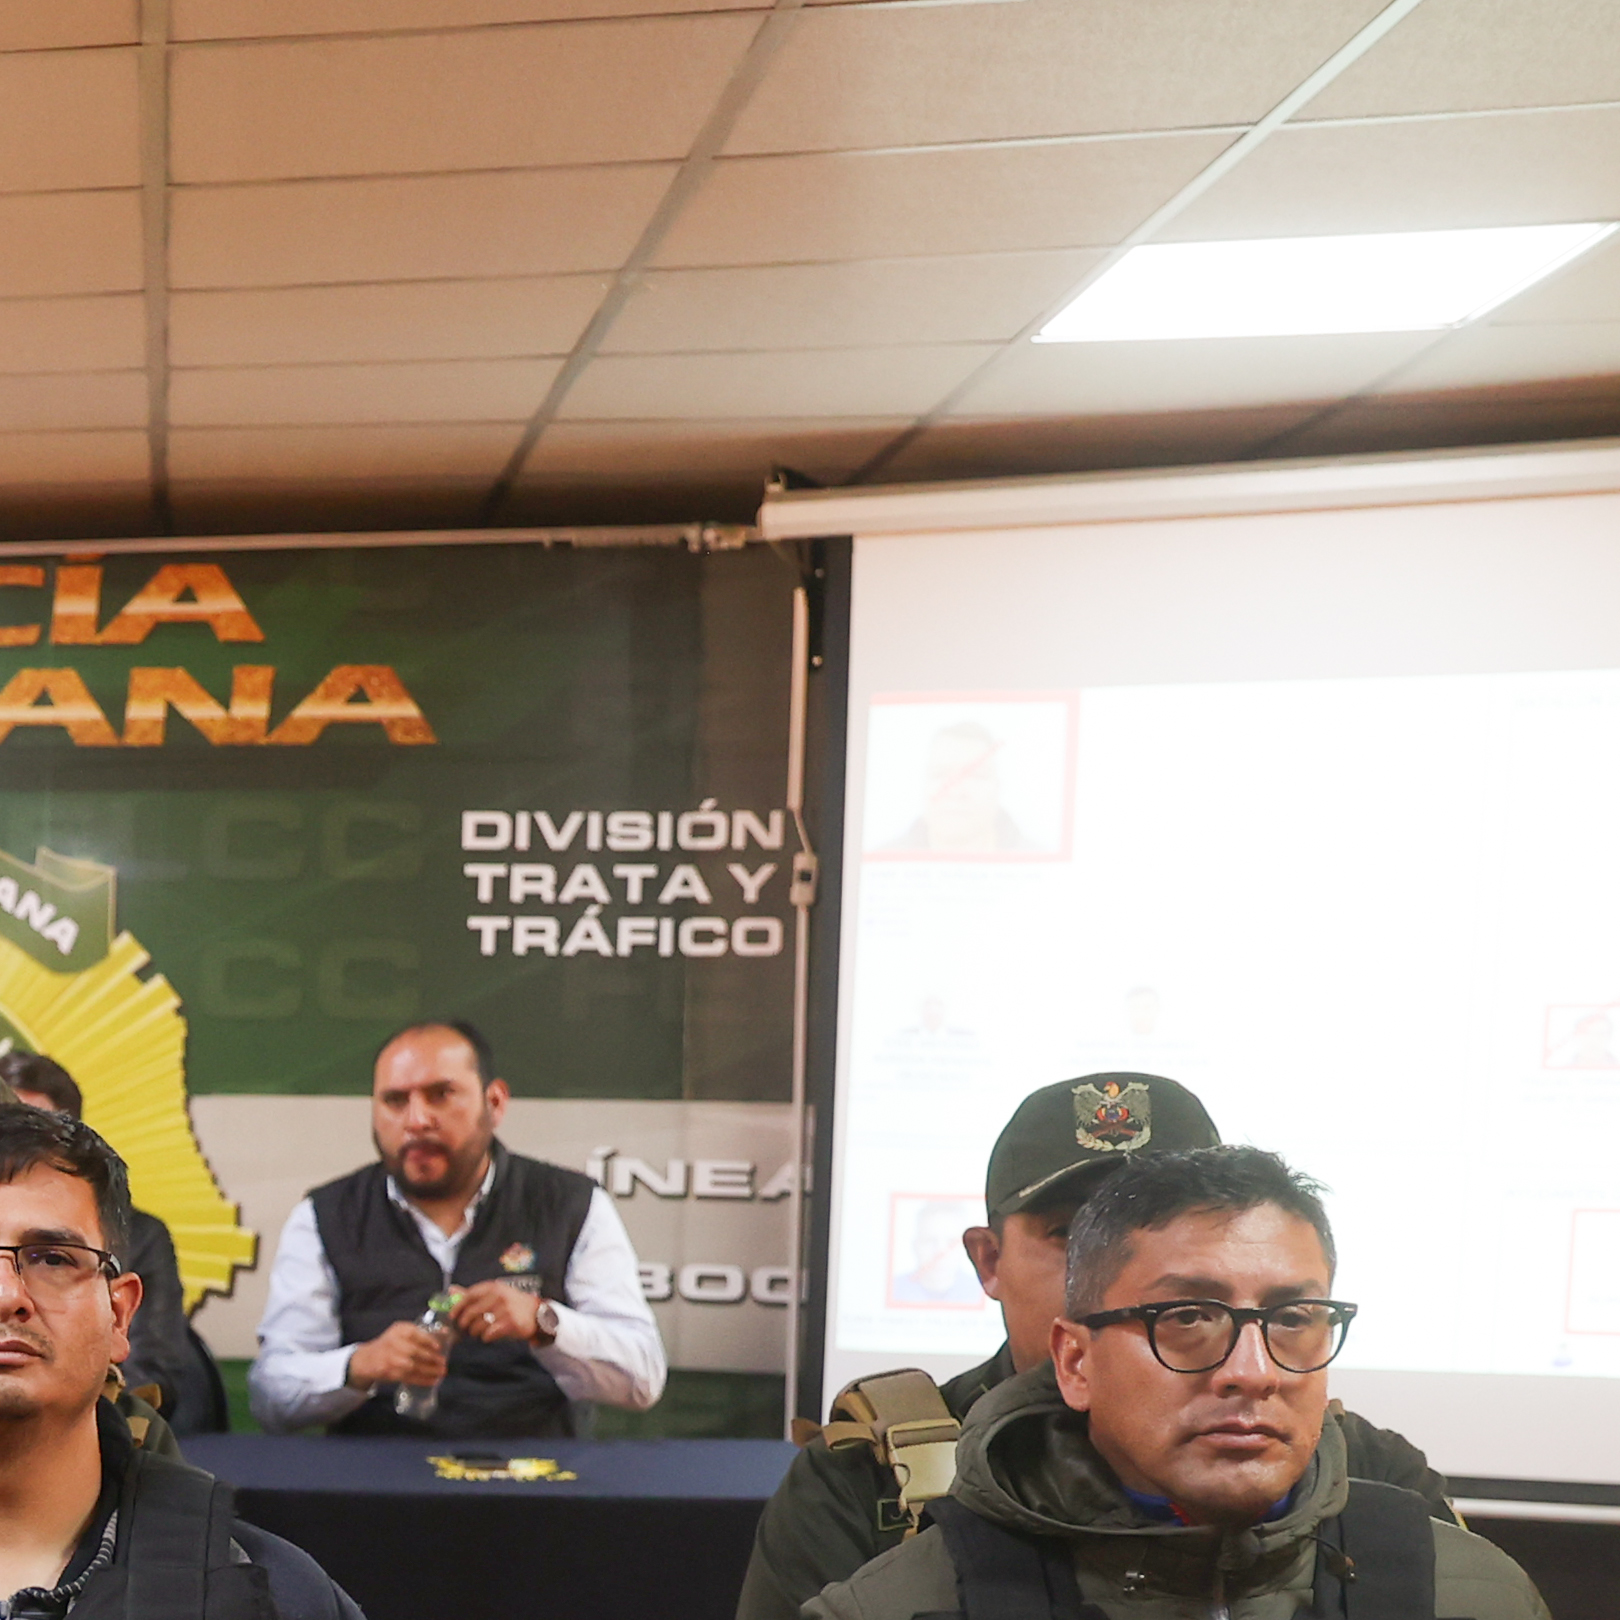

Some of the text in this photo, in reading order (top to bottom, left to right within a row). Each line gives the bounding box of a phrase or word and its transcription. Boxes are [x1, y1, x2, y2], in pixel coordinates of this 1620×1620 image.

[462, 798, 786, 852] DIVISIÓN
[464, 863, 777, 904] TRATA Y
[467, 906, 784, 956] TRÁFICO
